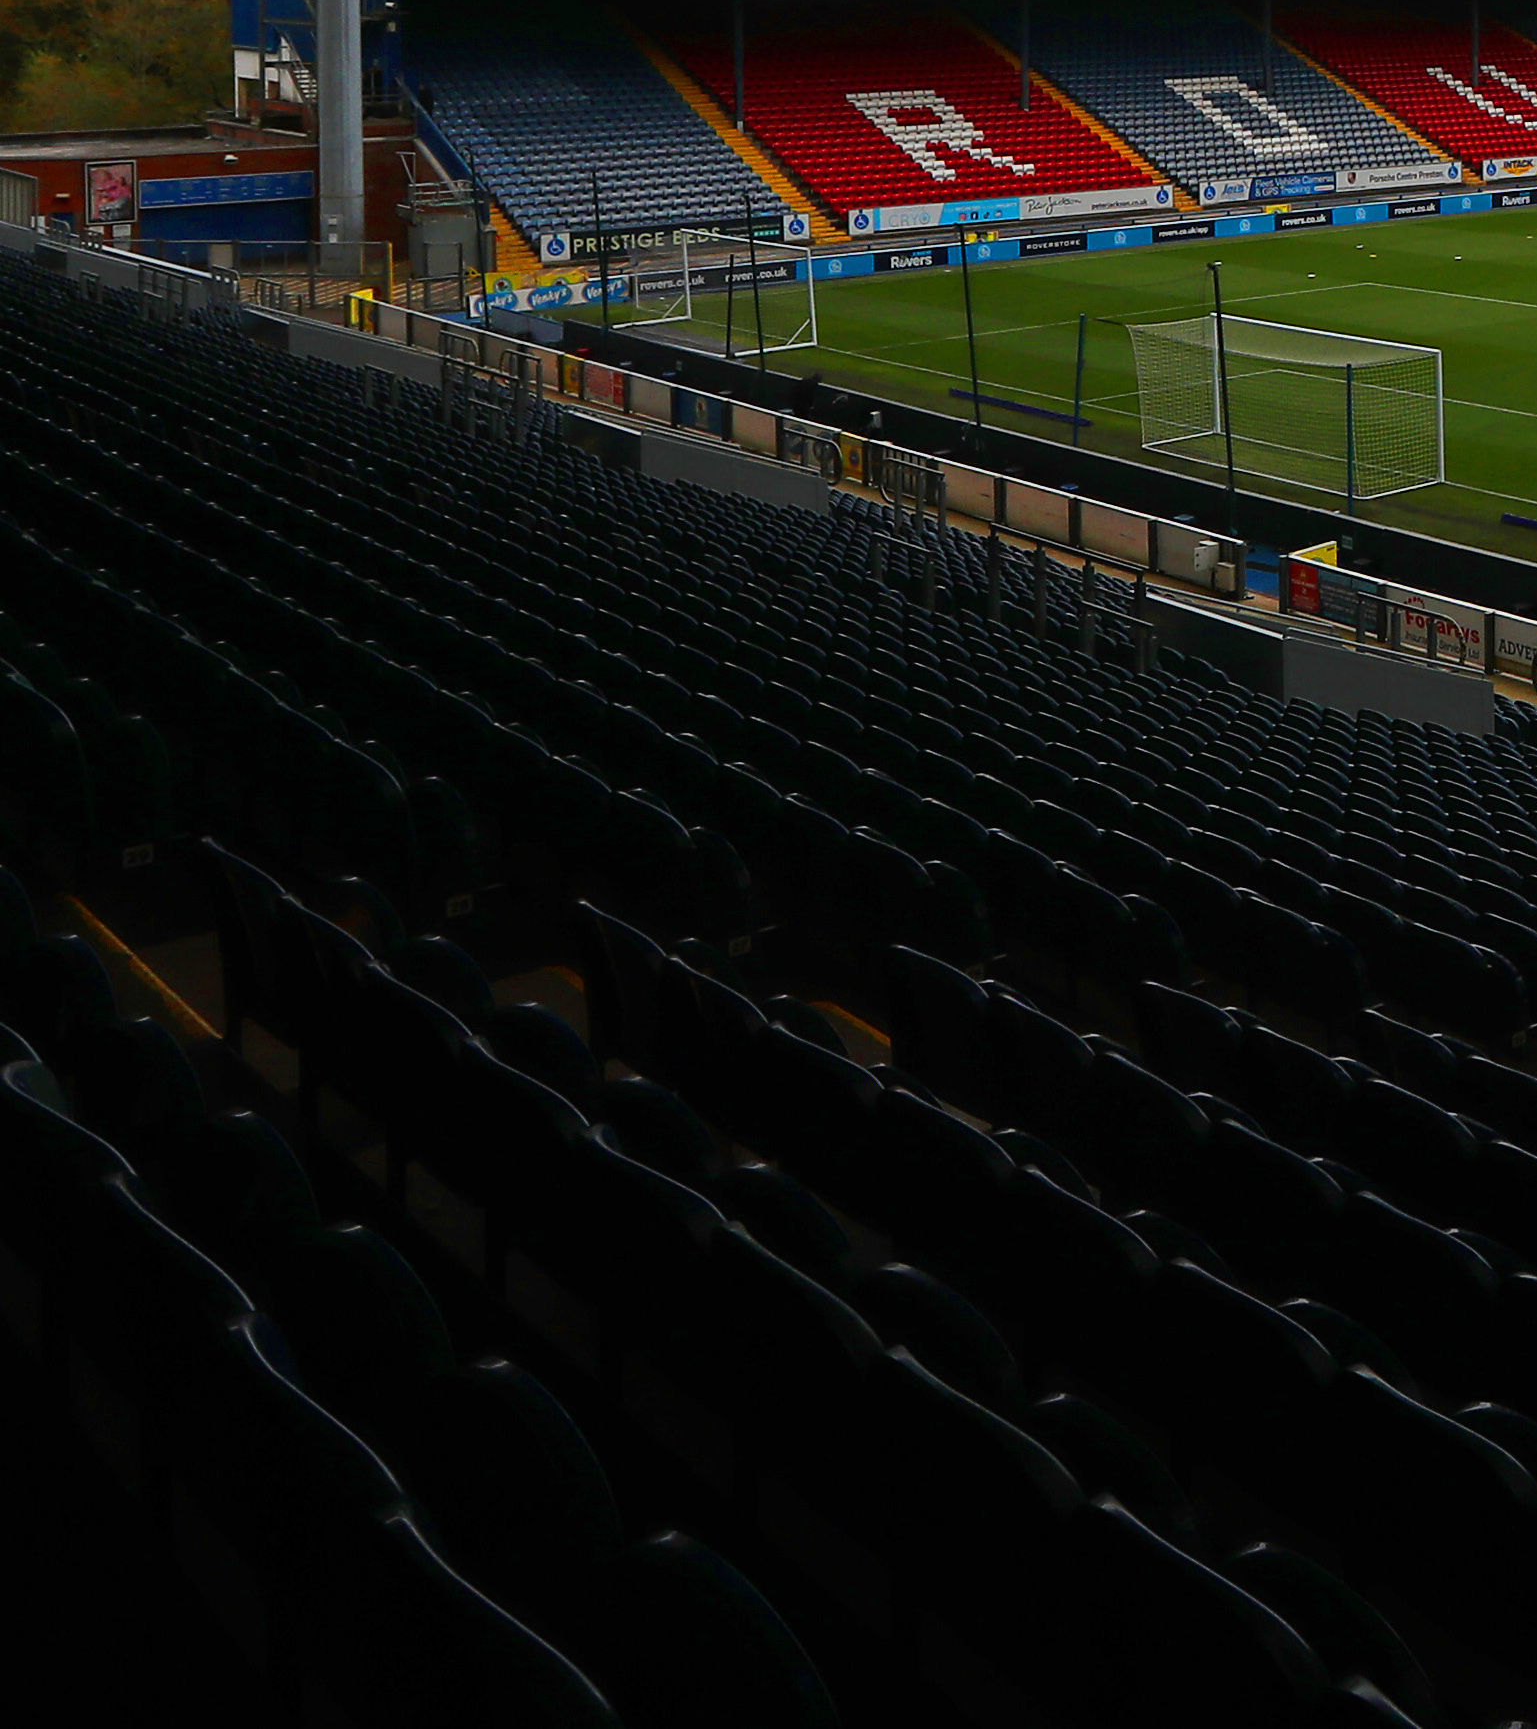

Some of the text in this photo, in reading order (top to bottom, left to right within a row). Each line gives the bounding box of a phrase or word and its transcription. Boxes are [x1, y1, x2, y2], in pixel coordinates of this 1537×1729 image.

[1503, 159, 1533, 169] INTACK
[1255, 175, 1334, 188] Fleet Vehicle Cameras
[1369, 171, 1444, 183] Porsche Centre Preston
[1255, 188, 1262, 197] &
[1262, 187, 1279, 196] GPS
[1281, 186, 1311, 196] Tracking
[1045, 196, 1082, 215] Jackson
[1091, 199, 1148, 211] peterjackson.co.uk
[1394, 203, 1437, 215] rovers.co.uk
[1282, 214, 1327, 227] rovers.co.uk
[673, 227, 721, 246] BEDS
[1159, 226, 1209, 237] rovers.co.uk/app
[1026, 239, 1081, 250] ROVERSTORE
[890, 255, 932, 269] Rovers
[586, 279, 622, 299] Vey's
[477, 294, 513, 311] Vnky's
[531, 288, 567, 307] Venky's
